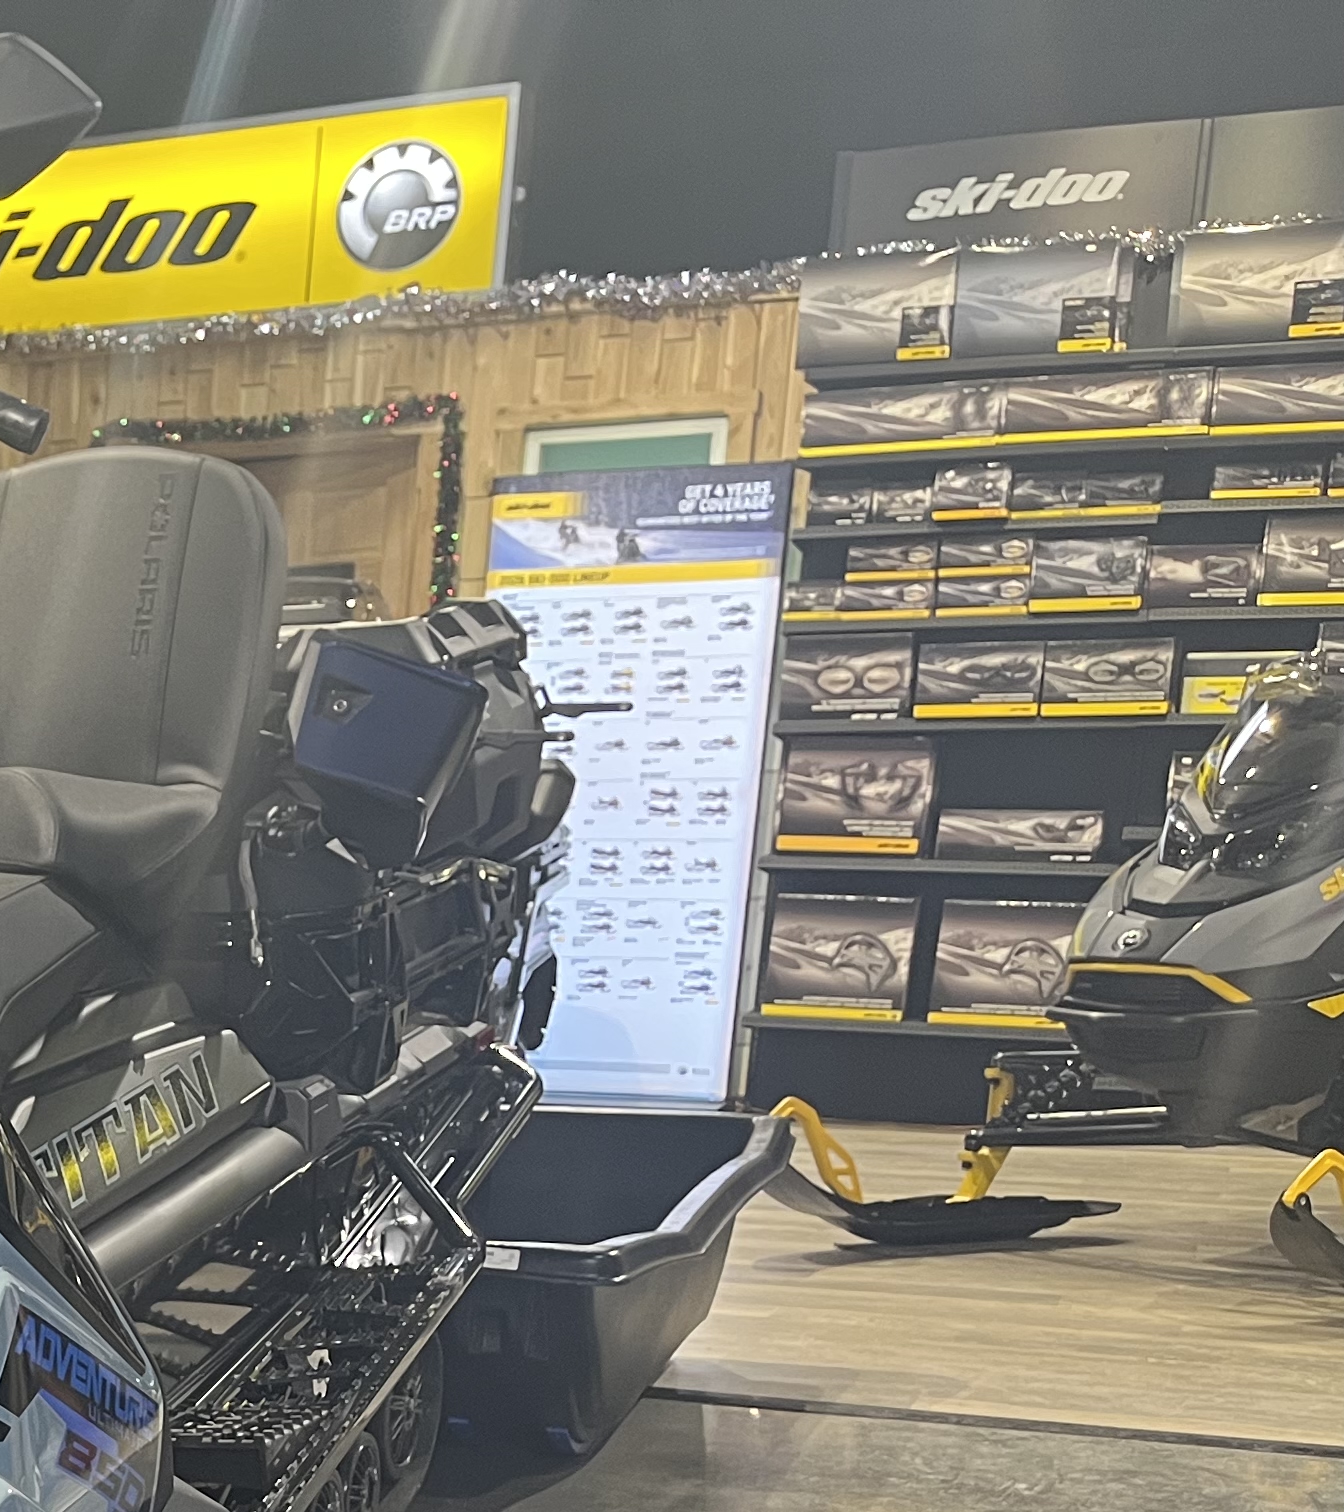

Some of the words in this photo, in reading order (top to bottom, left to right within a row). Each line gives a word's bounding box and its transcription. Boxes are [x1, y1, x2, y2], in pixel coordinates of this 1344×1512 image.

[381, 203, 458, 235] BRP
[905, 167, 1131, 222] ski-doo
[129, 470, 178, 660] POLARIS
[14, 1314, 159, 1432] ADVENTURE
